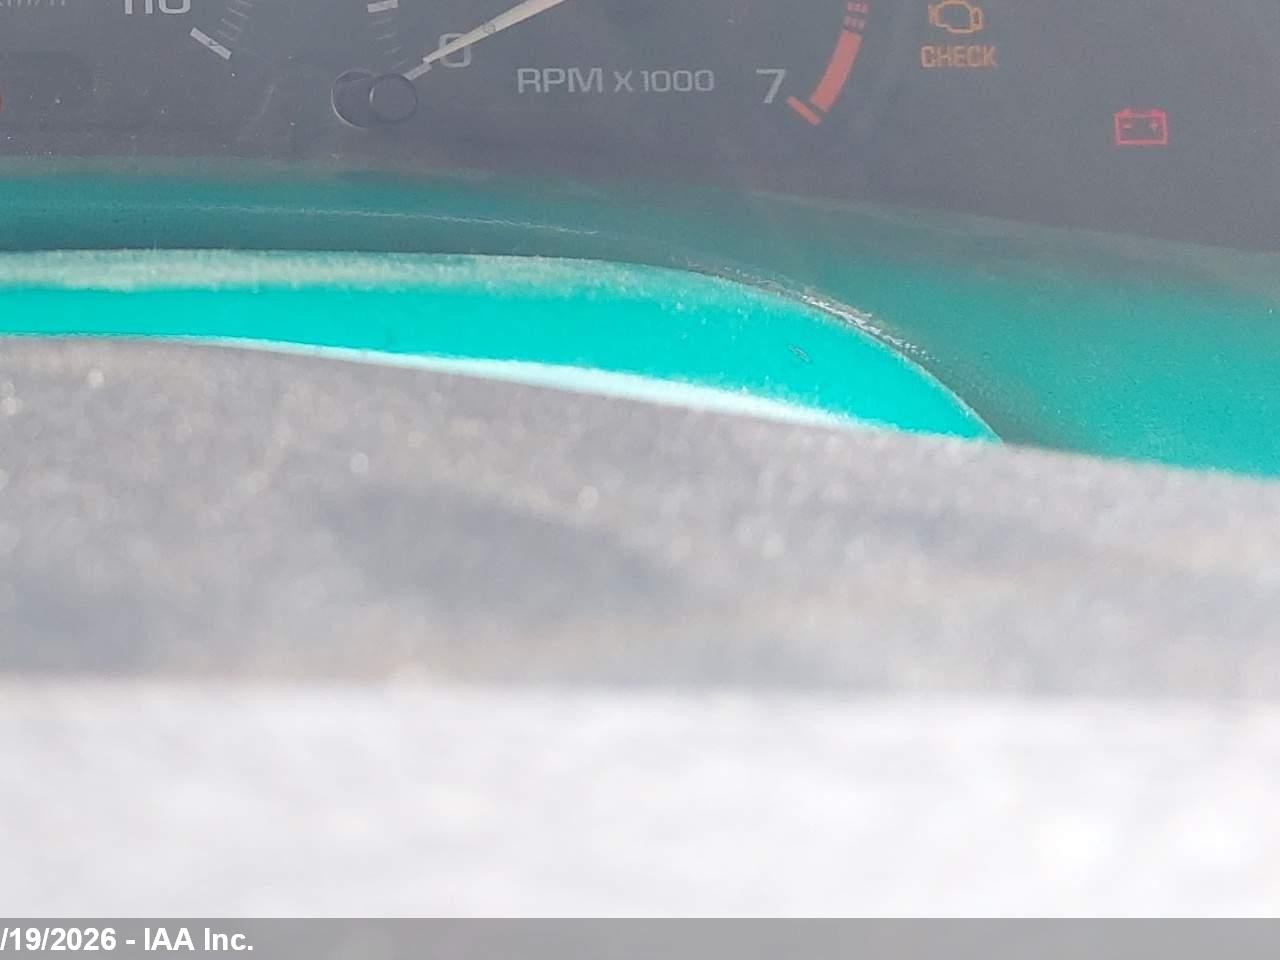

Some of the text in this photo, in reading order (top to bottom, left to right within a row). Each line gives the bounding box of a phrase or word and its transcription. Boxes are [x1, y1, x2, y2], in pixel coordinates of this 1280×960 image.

[921, 45, 997, 68] CHECK
[517, 67, 603, 93] RPM
[642, 70, 714, 93] 1000
[756, 68, 786, 104] 7
